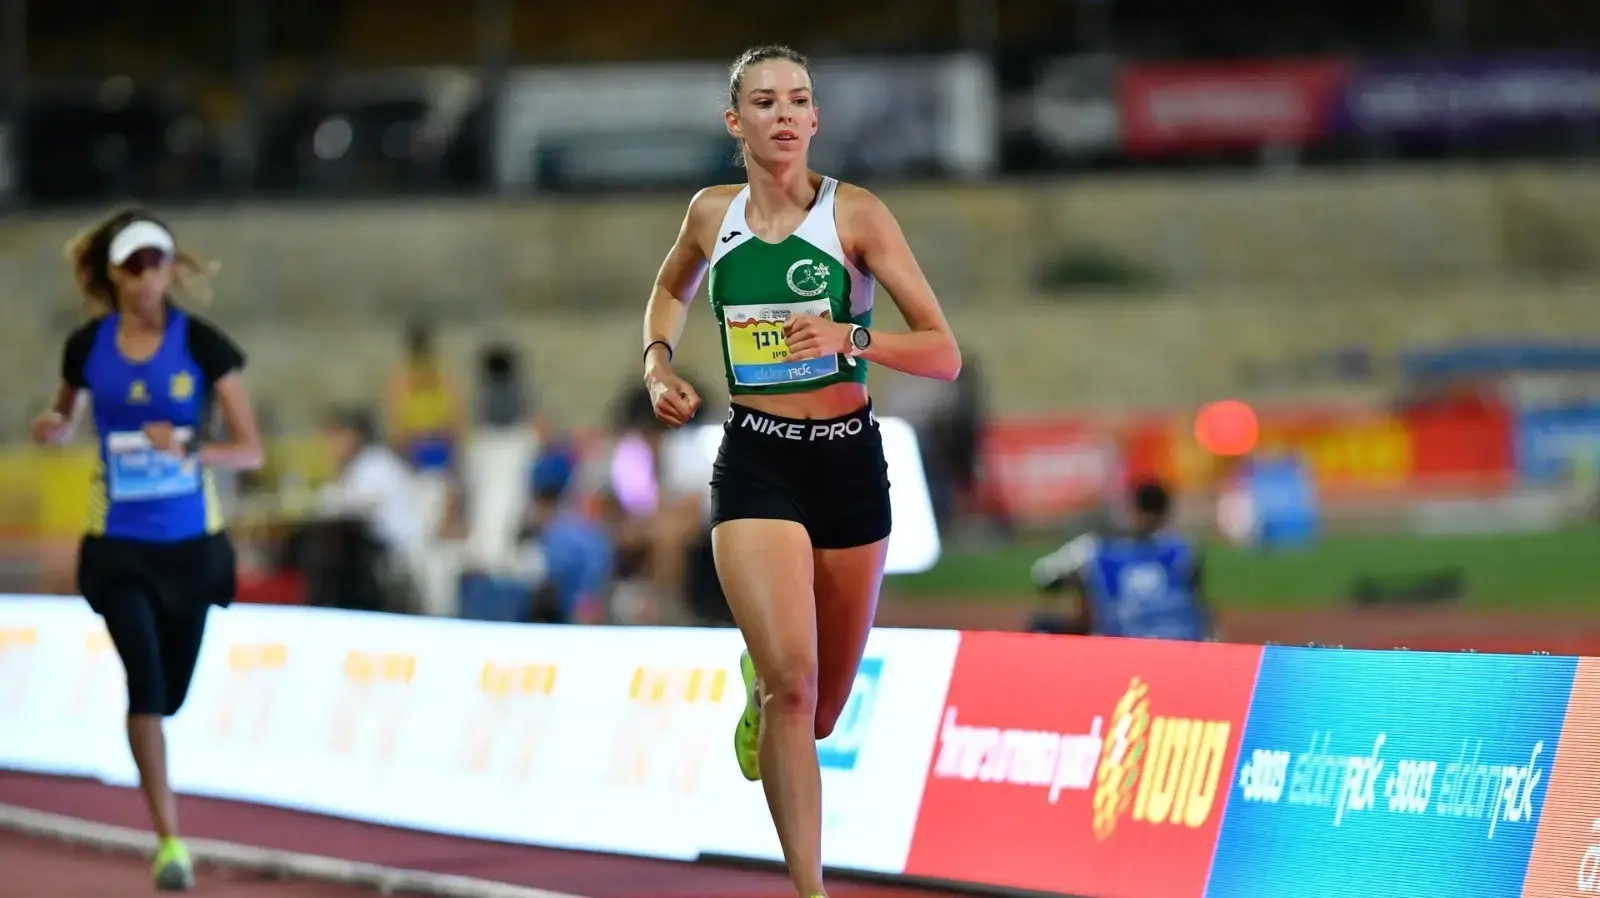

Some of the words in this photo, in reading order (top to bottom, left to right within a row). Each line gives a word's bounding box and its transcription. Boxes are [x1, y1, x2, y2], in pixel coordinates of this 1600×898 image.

[772, 350, 787, 359] סיון
[741, 413, 805, 441] NIKE
[809, 417, 863, 441] PRO
[1133, 716, 1231, 828] טוטו
